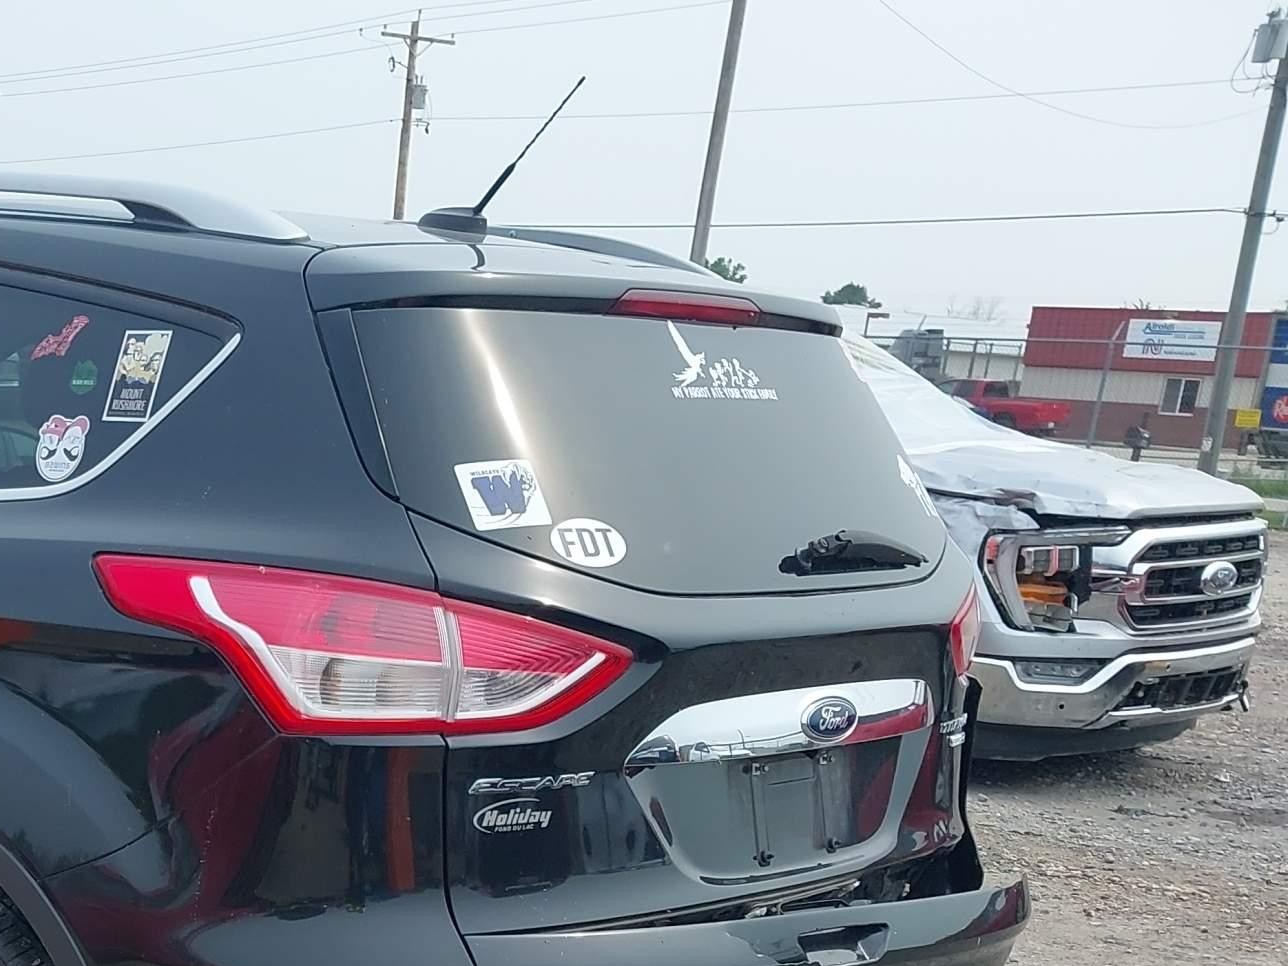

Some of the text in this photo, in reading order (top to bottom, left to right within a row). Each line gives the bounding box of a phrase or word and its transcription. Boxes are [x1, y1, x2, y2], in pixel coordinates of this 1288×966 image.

[711, 387, 726, 399] ATE
[470, 470, 527, 517] W
[558, 528, 616, 558] FDT
[819, 706, 849, 731] Ford
[468, 771, 596, 795] ESCAPE
[482, 807, 552, 828] Holiday
